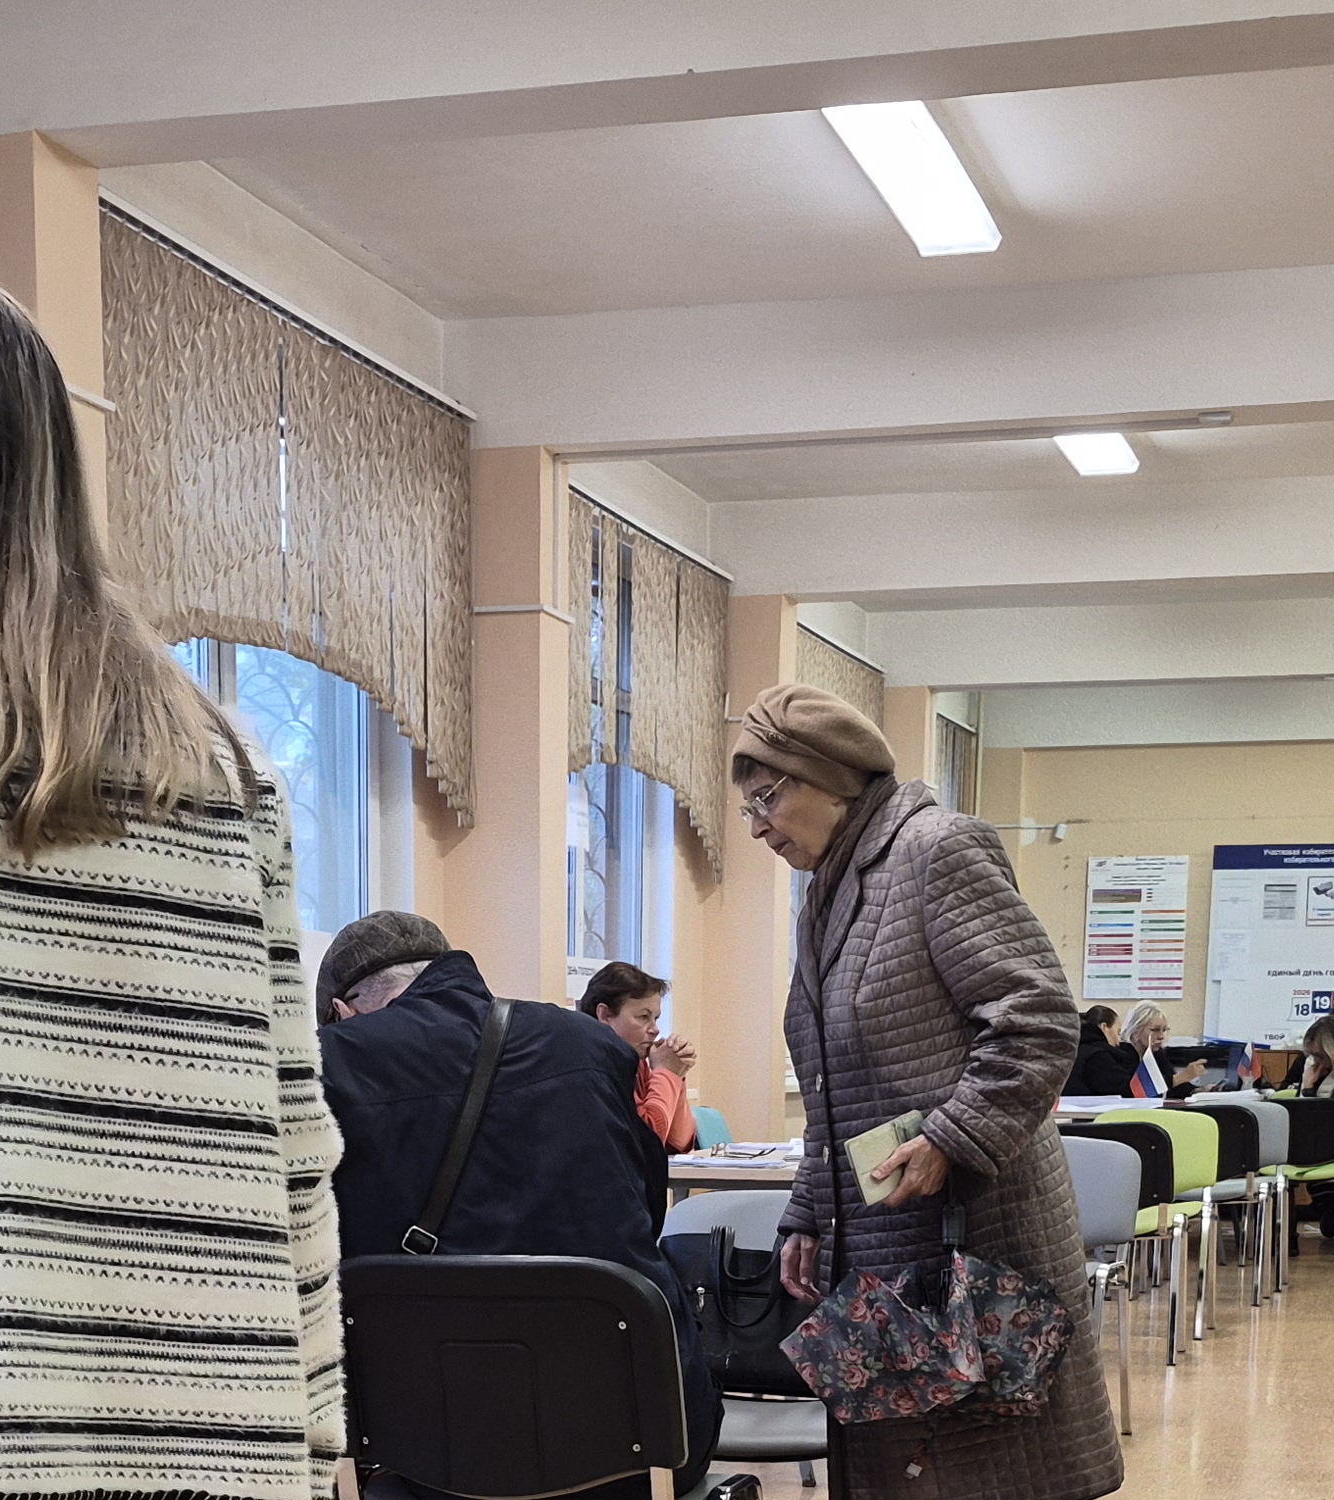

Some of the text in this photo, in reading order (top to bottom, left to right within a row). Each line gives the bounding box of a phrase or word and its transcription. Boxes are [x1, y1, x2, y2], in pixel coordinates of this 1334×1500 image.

[1267, 969, 1301, 977] ЕДИНЫЙ
[1302, 969, 1324, 977] ДЕНЬ
[1313, 995, 1331, 1010] 19
[1294, 1003, 1310, 1016] 18
